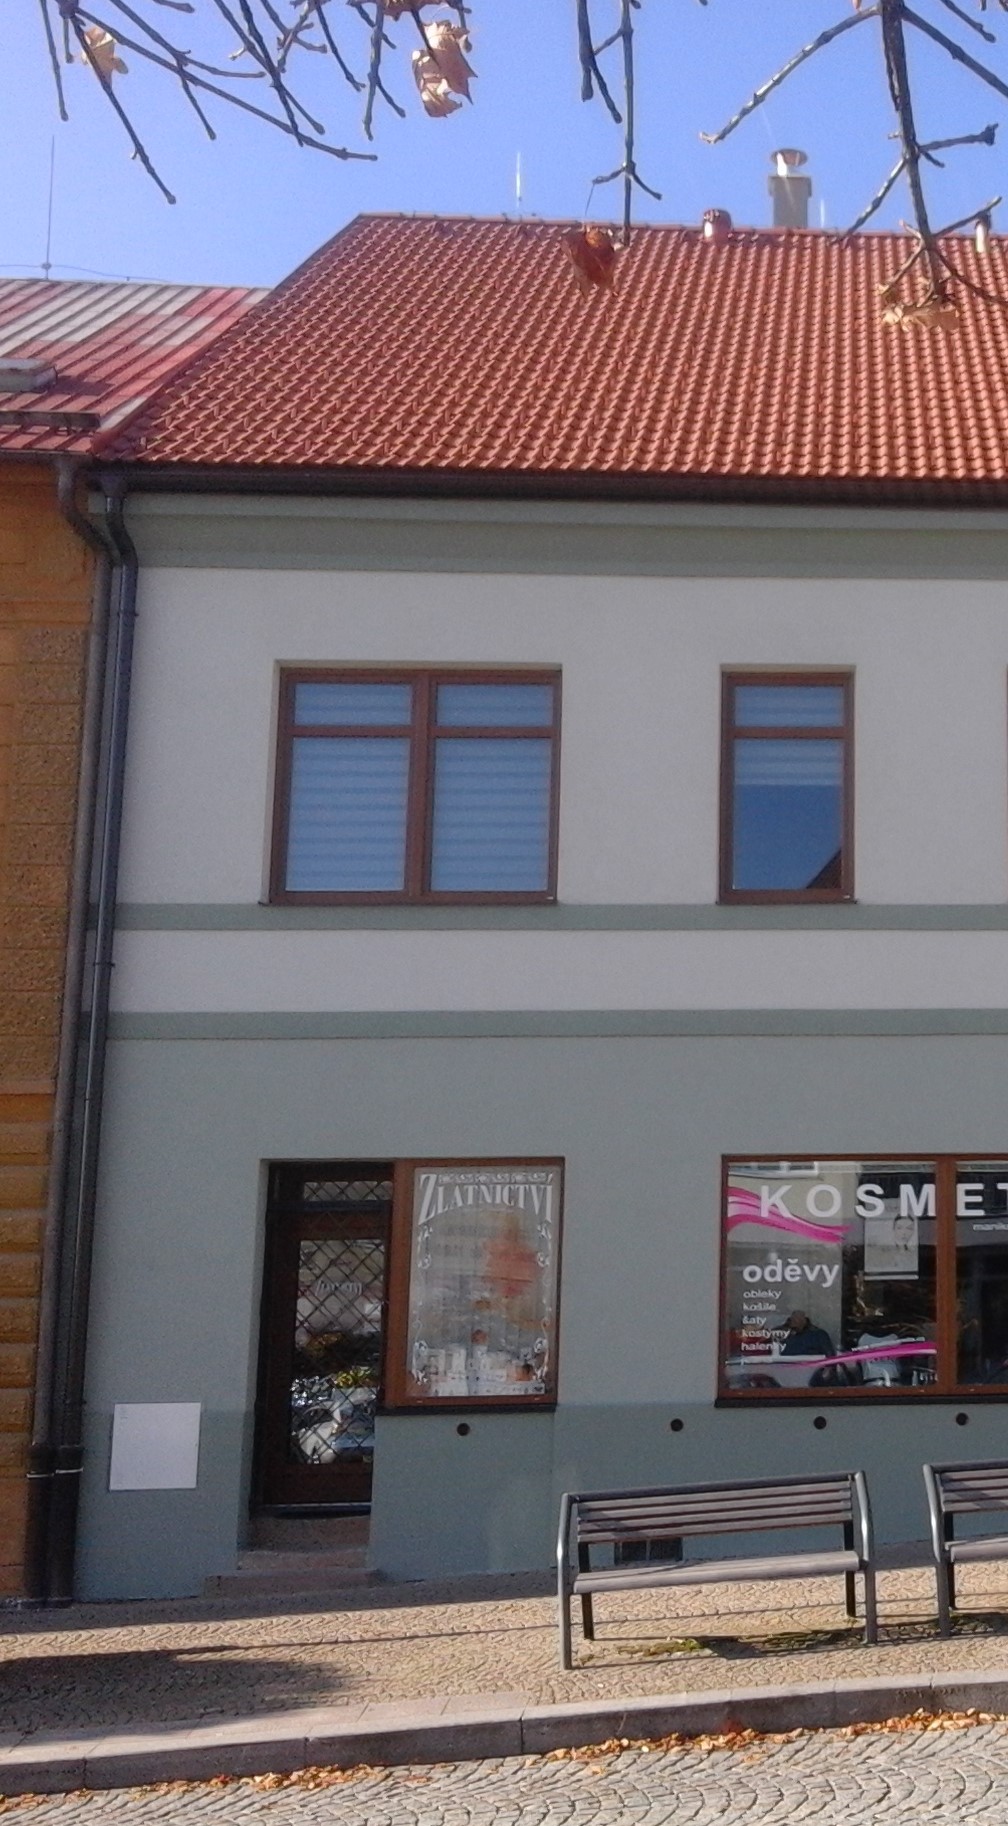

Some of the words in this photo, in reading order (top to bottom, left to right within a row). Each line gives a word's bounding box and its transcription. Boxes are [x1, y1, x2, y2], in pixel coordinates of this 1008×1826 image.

[418, 1172, 552, 1225] ZLATNICTVÍ
[743, 1258, 840, 1288] oděvy
[743, 1289, 782, 1299] obleky
[743, 1302, 776, 1312] košile
[743, 1315, 766, 1327] šaty
[742, 1328, 791, 1340] kostýmy
[741, 1342, 787, 1352] halenky
